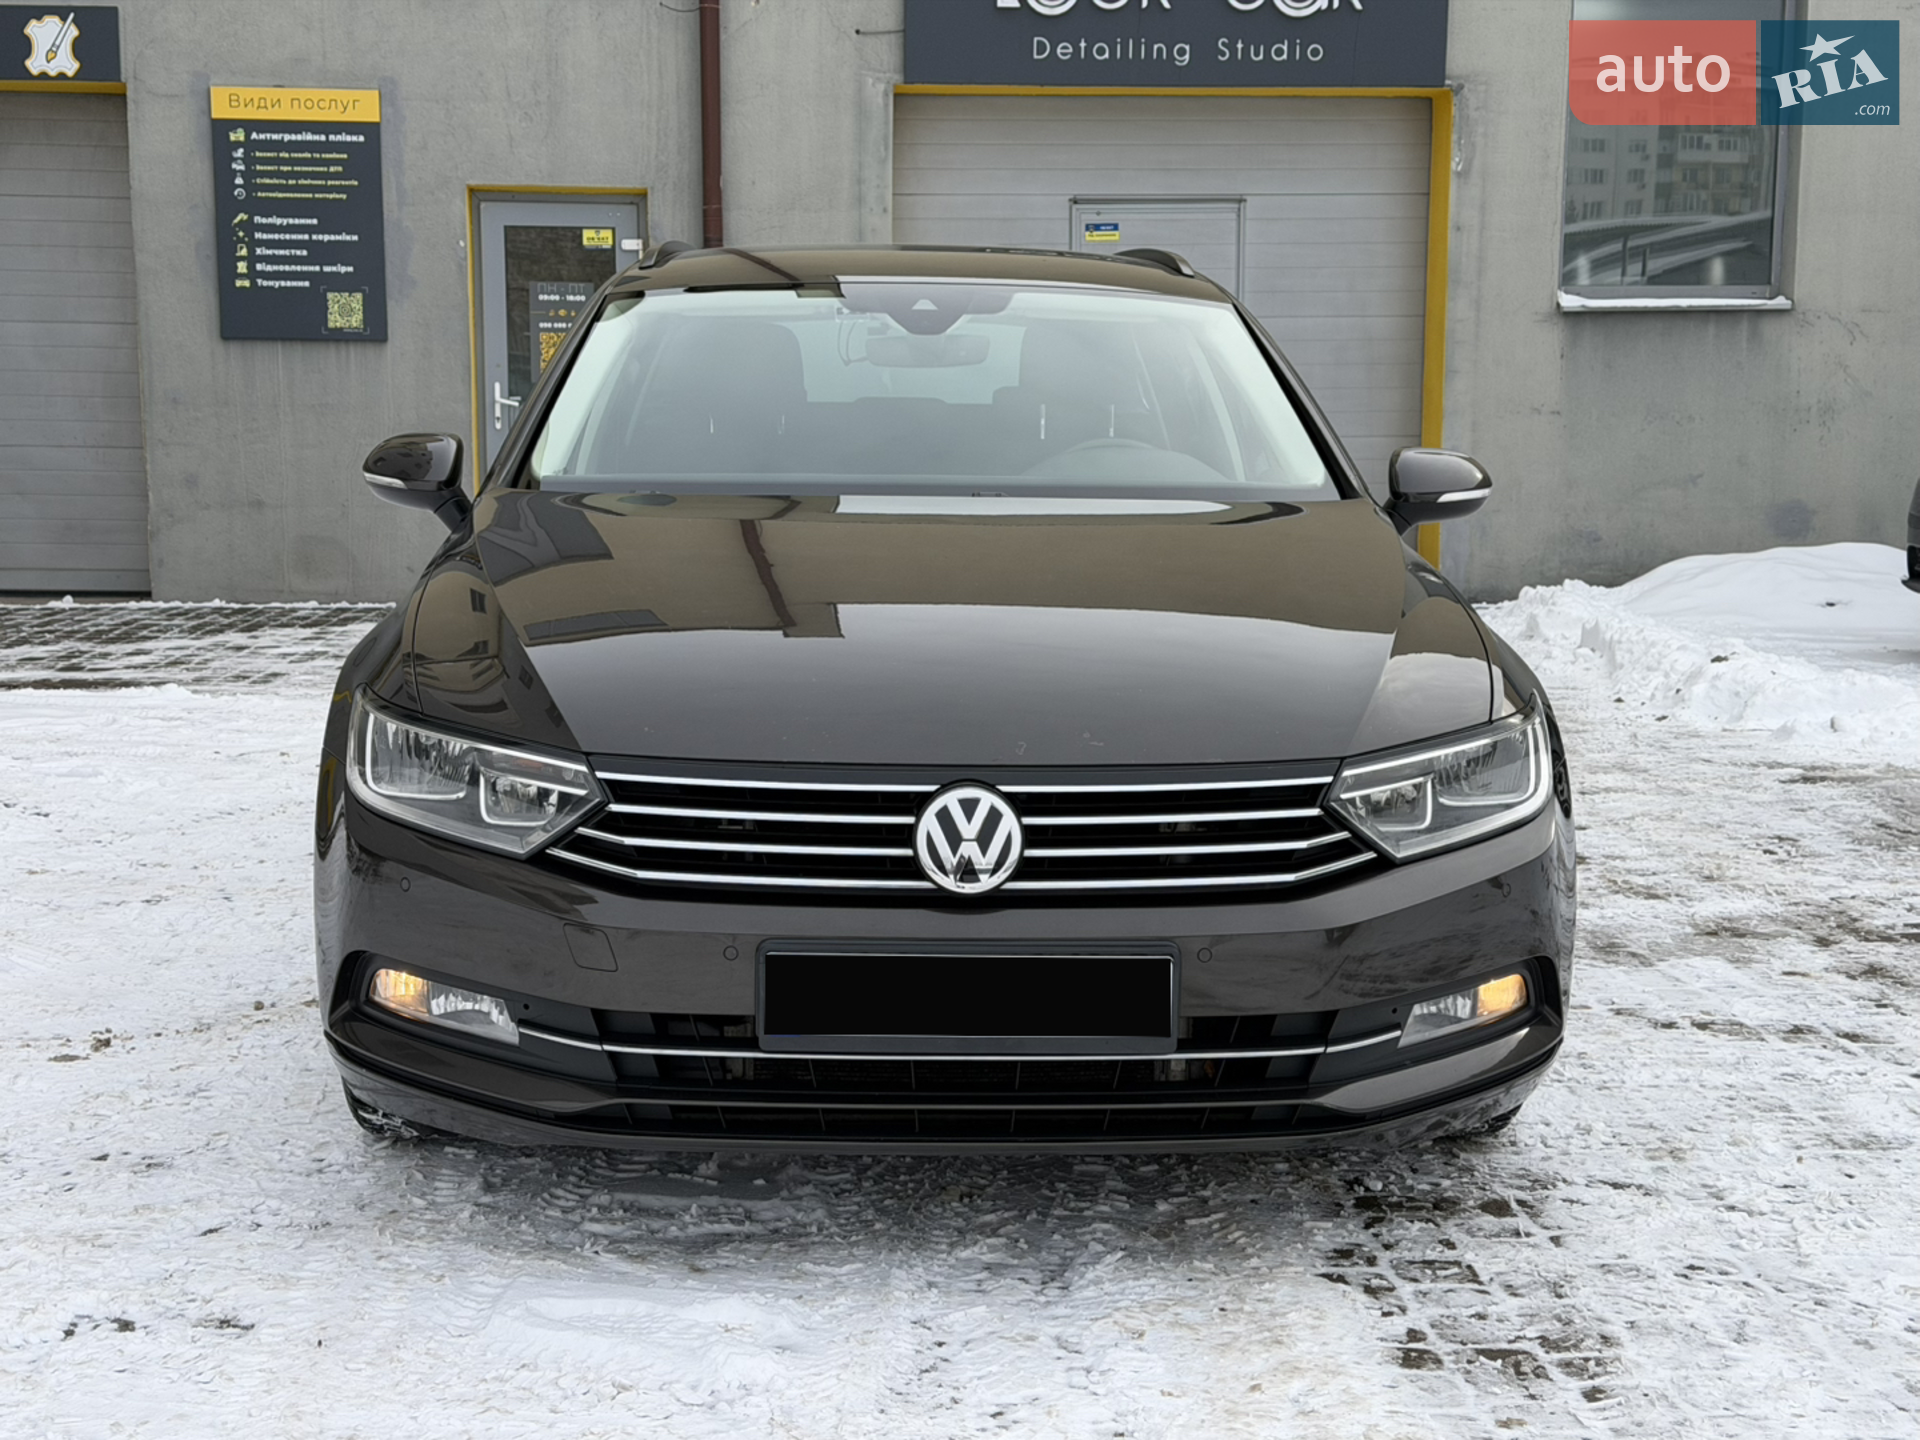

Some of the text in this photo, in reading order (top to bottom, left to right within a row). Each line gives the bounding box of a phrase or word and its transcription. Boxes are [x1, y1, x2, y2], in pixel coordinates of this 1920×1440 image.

[1032, 36, 1324, 66] Detailing Studio
[227, 92, 361, 114] Види послуг
[250, 131, 365, 143] Антигравійна плівка
[253, 215, 319, 227] Полірування
[254, 231, 359, 243] Нанесення кераміки
[255, 246, 308, 256] Хімчистка
[255, 262, 354, 275] Відновлення шкіри
[255, 278, 310, 289] Тонування
